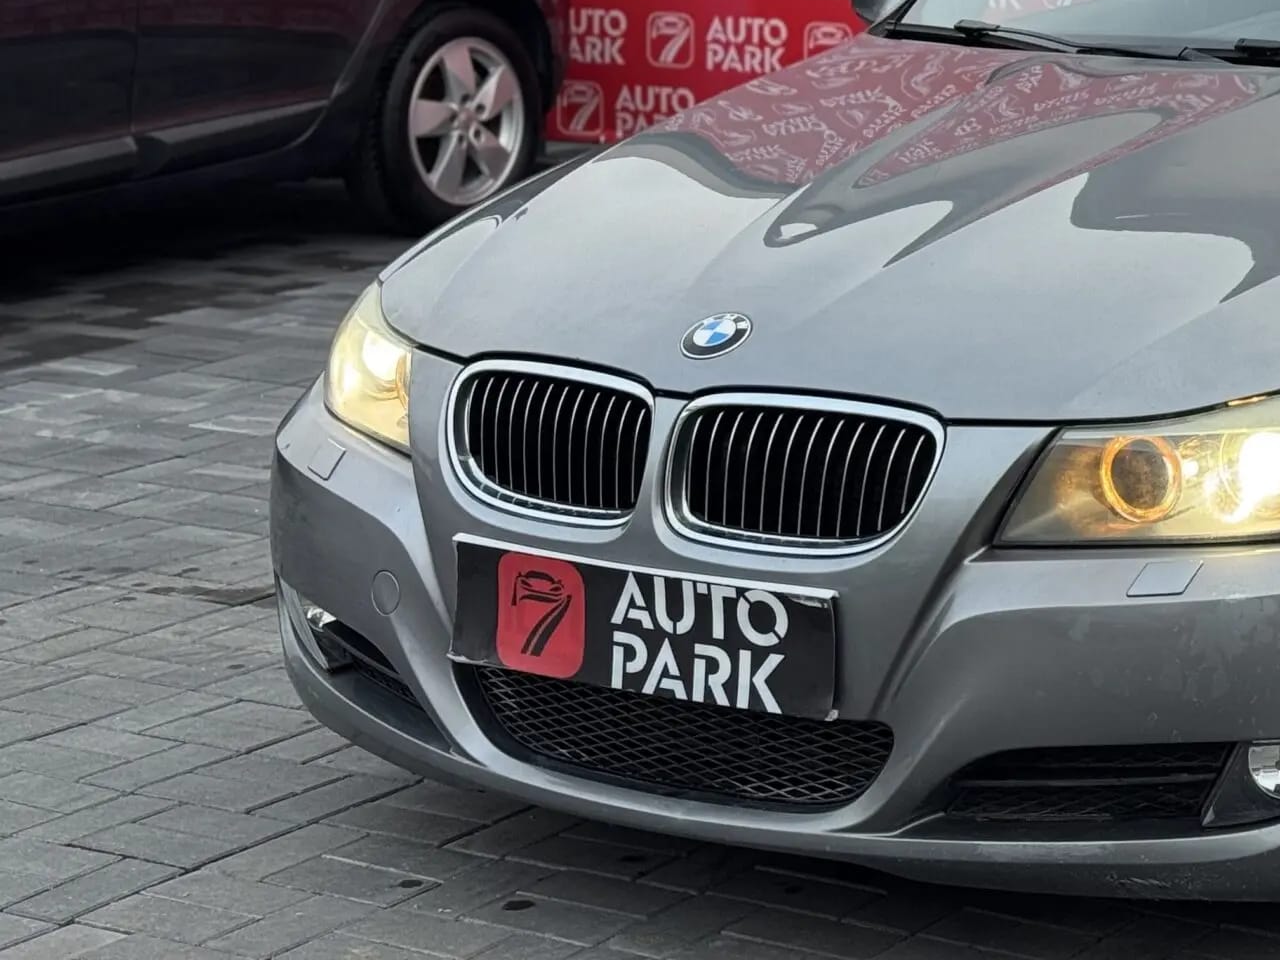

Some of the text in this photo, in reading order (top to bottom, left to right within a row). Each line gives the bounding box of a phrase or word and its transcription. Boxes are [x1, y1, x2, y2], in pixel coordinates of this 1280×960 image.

[707, 17, 787, 46] AUTO
[707, 43, 784, 74] PARK
[615, 84, 695, 114] AUTO
[610, 572, 789, 646] AUTO
[610, 630, 786, 714] PARK
